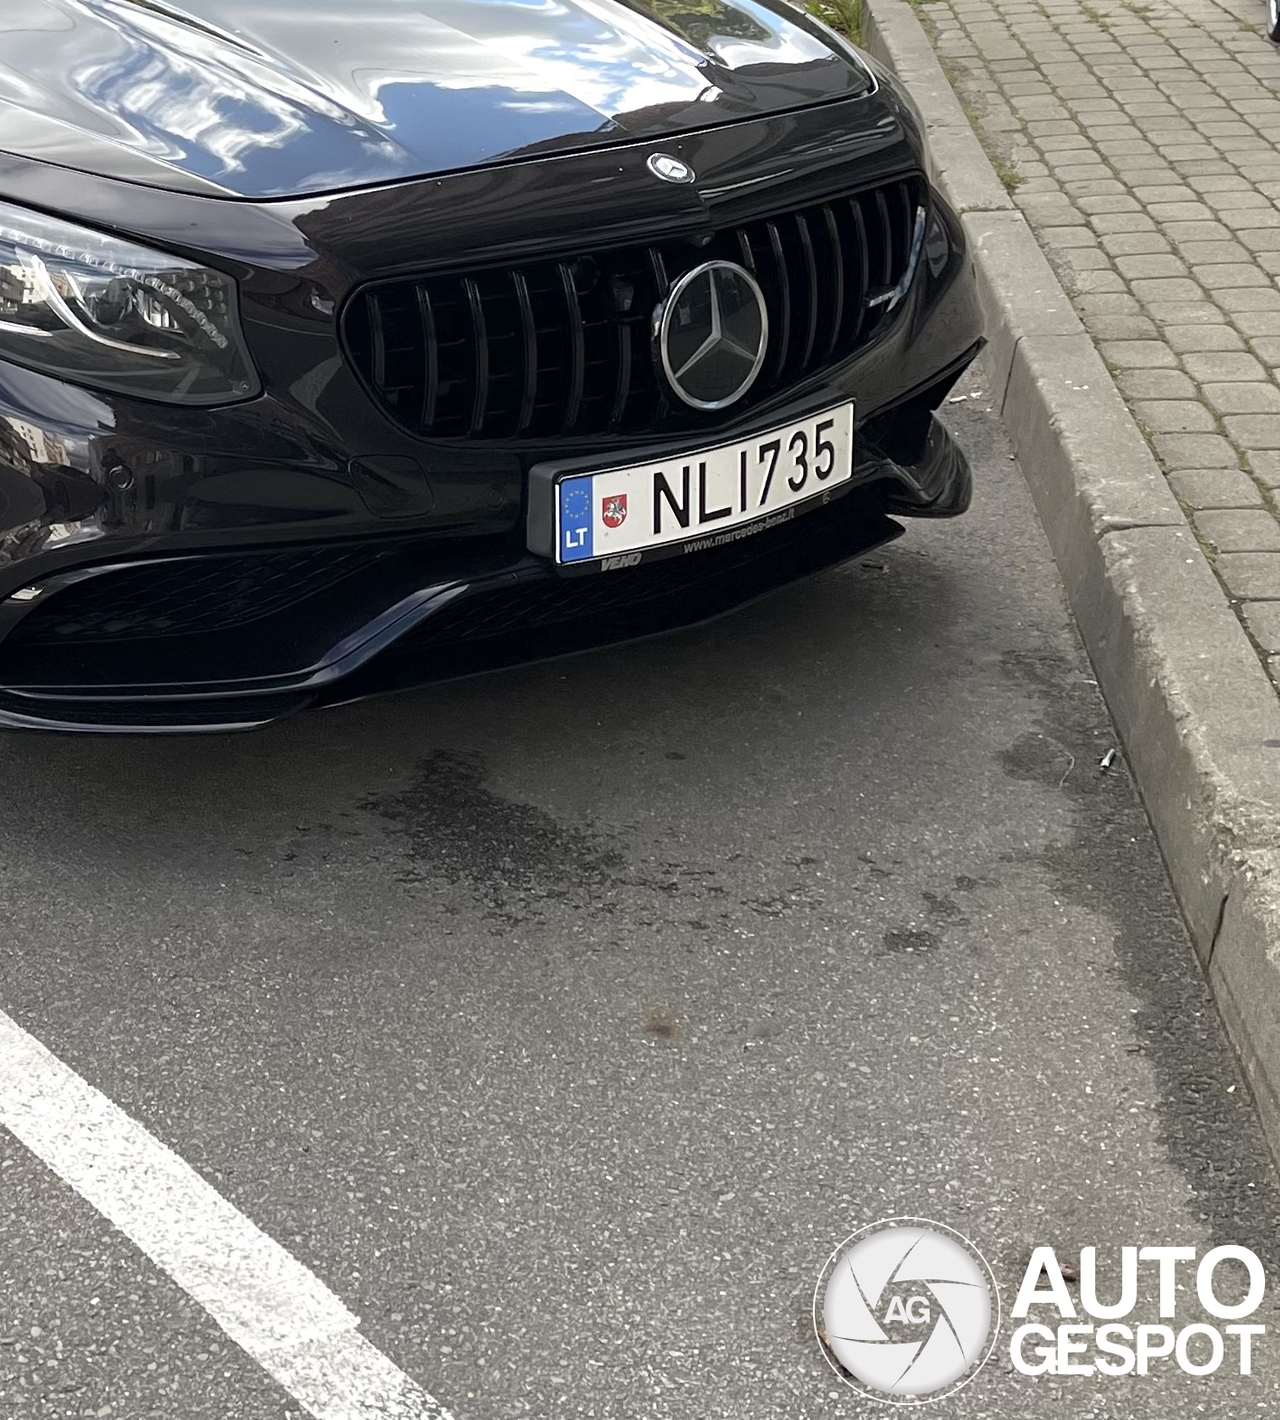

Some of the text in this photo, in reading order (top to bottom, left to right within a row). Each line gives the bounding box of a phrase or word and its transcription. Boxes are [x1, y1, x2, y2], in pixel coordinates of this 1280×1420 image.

[565, 527, 587, 548] LT
[683, 507, 796, 554] www.mercedes-benz.lt
[601, 552, 642, 572] VEHO
